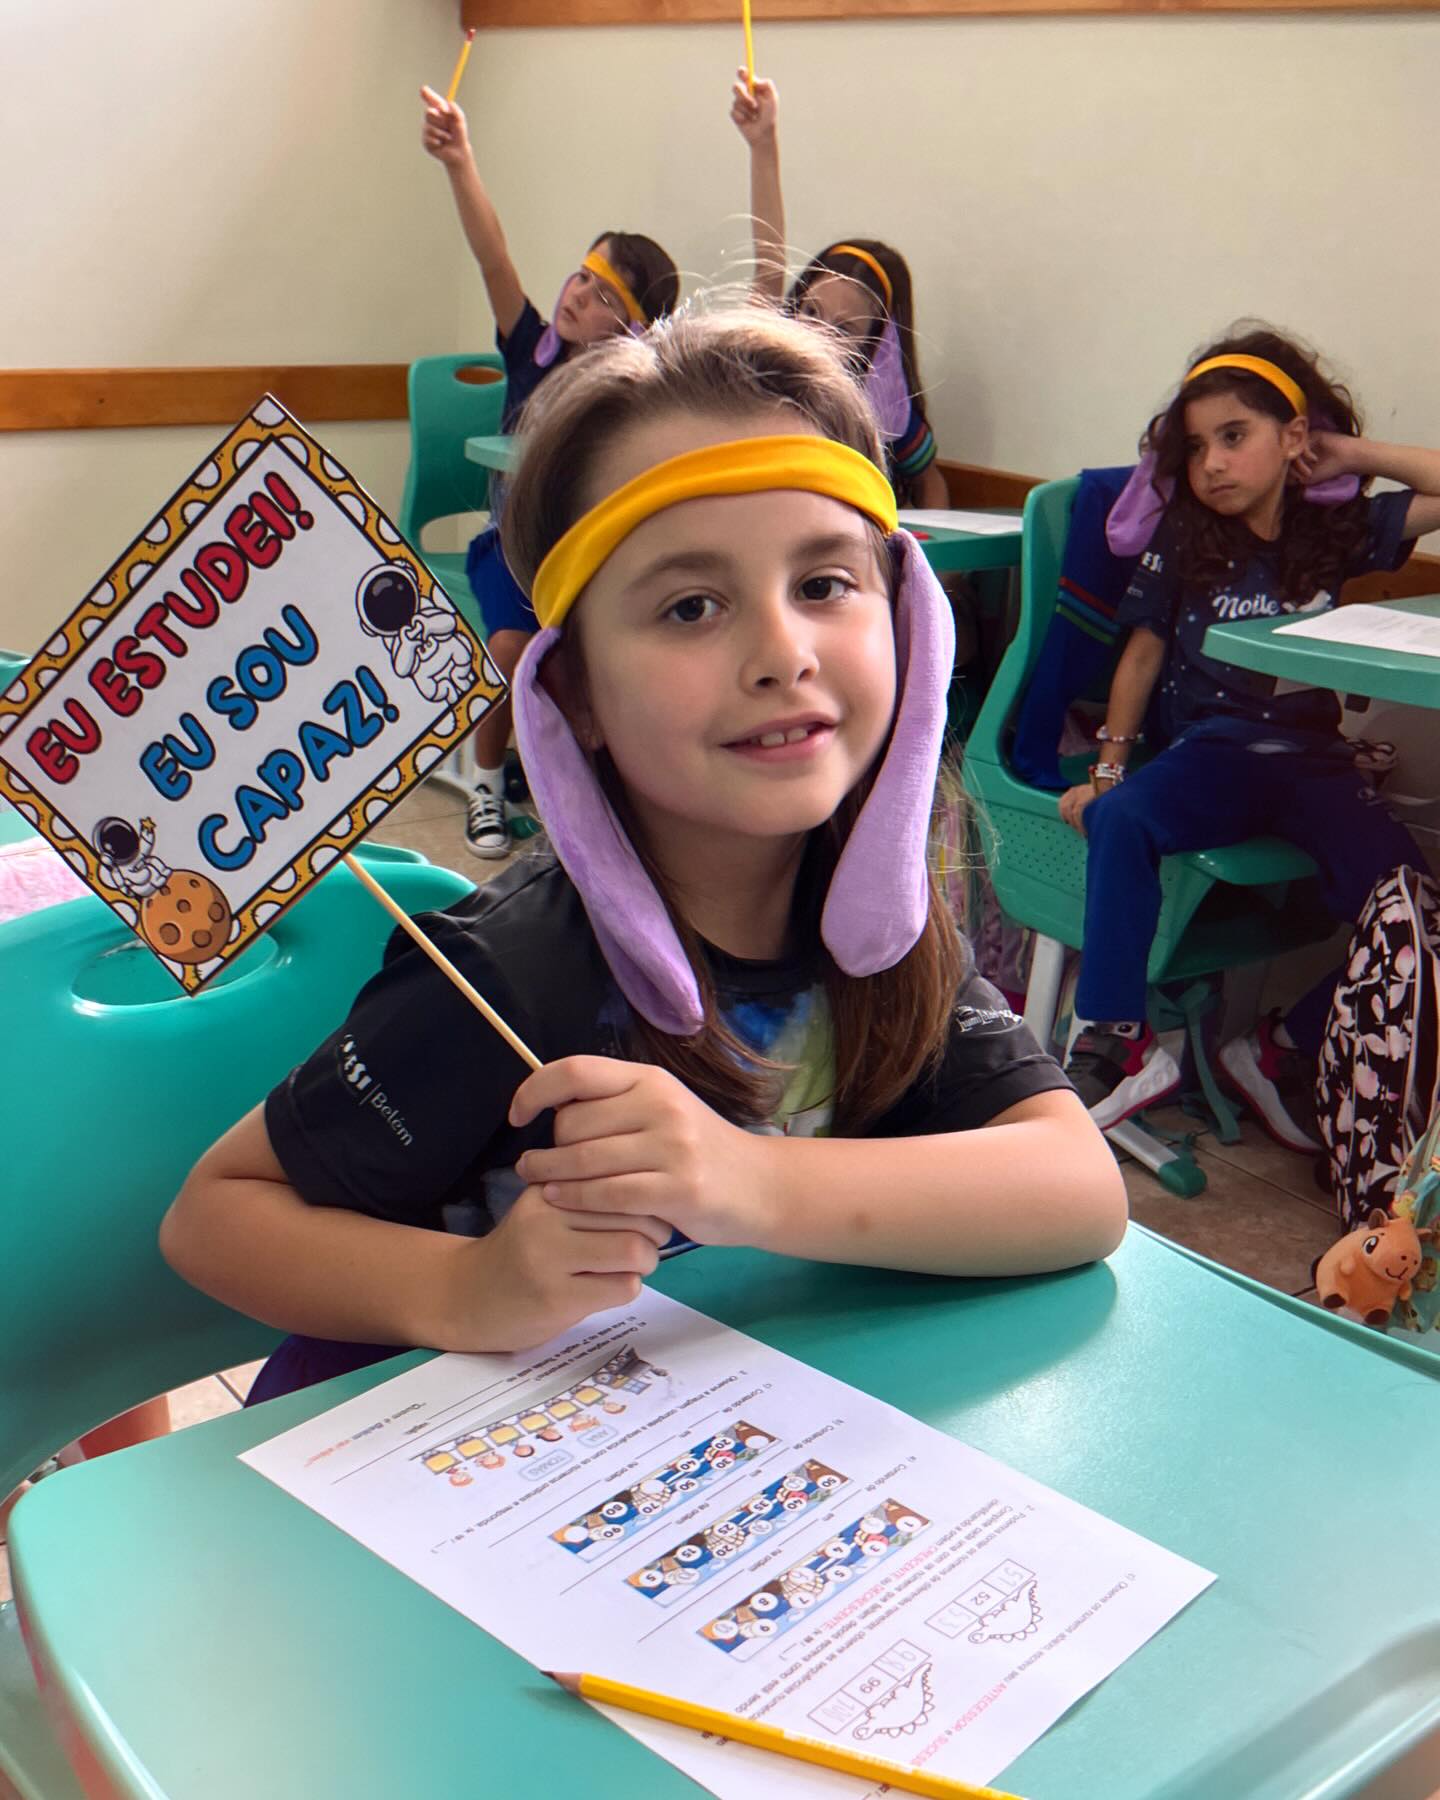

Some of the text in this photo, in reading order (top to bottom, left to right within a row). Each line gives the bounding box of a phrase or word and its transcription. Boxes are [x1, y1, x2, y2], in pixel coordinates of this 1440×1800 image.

[26, 471, 315, 784] EU ESTUDEI!
[139, 603, 319, 801] EU SOU
[198, 664, 400, 871] CAPAZ!
[371, 1091, 413, 1146] Belém
[712, 1438, 732, 1449] 20
[677, 1458, 699, 1470] 40
[712, 1458, 732, 1469] 30
[676, 1479, 697, 1491] 50
[818, 1476, 838, 1488] 50
[602, 1503, 625, 1516] 80
[638, 1502, 660, 1514] 70
[751, 1500, 770, 1511] 35
[784, 1497, 805, 1510] 40
[600, 1525, 623, 1538] 90
[715, 1523, 736, 1535] 25
[678, 1547, 698, 1558] 15
[713, 1544, 734, 1556] 20
[830, 1545, 845, 1554] 4
[867, 1544, 881, 1553] 3
[643, 1573, 659, 1582] 5
[831, 1569, 847, 1578] 5
[755, 1597, 771, 1606] 8
[794, 1595, 810, 1605] 7
[968, 1590, 992, 1606] 52
[756, 1623, 772, 1632] 9
[855, 1676, 884, 1695] 99
